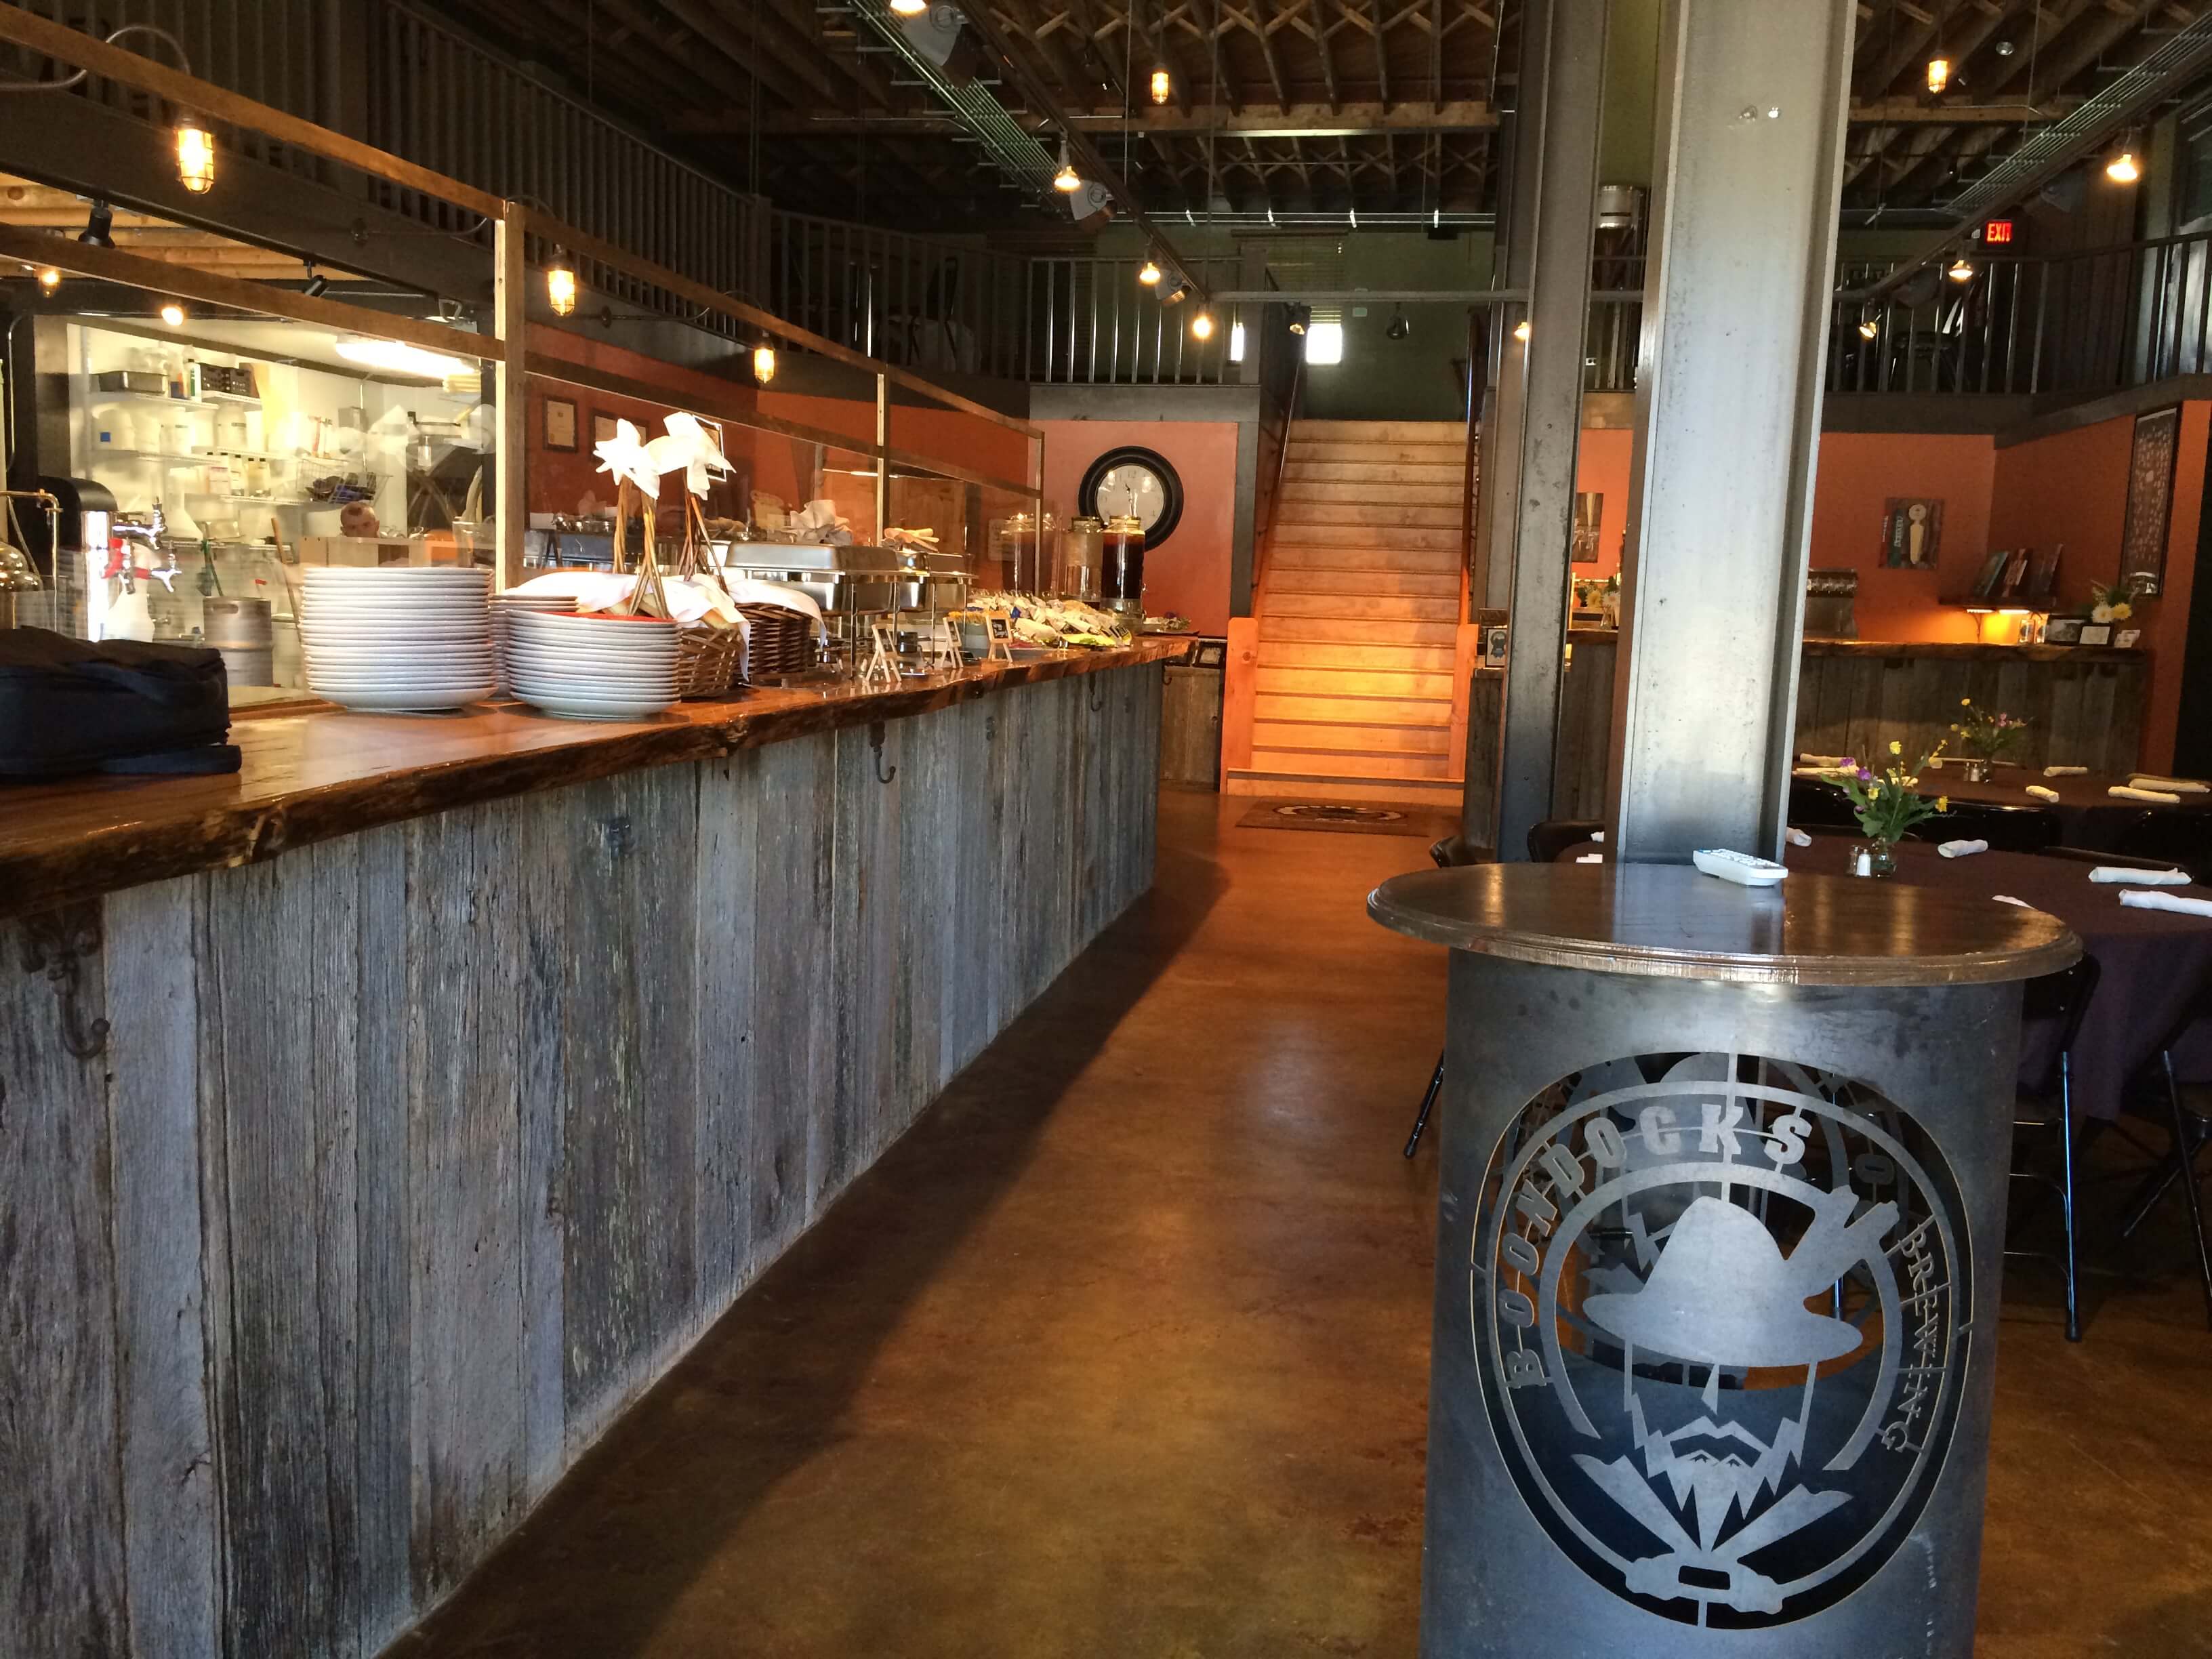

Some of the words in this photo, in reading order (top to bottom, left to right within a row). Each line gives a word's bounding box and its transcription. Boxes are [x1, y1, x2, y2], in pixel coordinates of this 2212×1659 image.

[1987, 222, 2011, 241] EXIT
[1498, 1105, 1812, 1390] BOONDOCKS
[1881, 1223, 1939, 1453] BREWING
